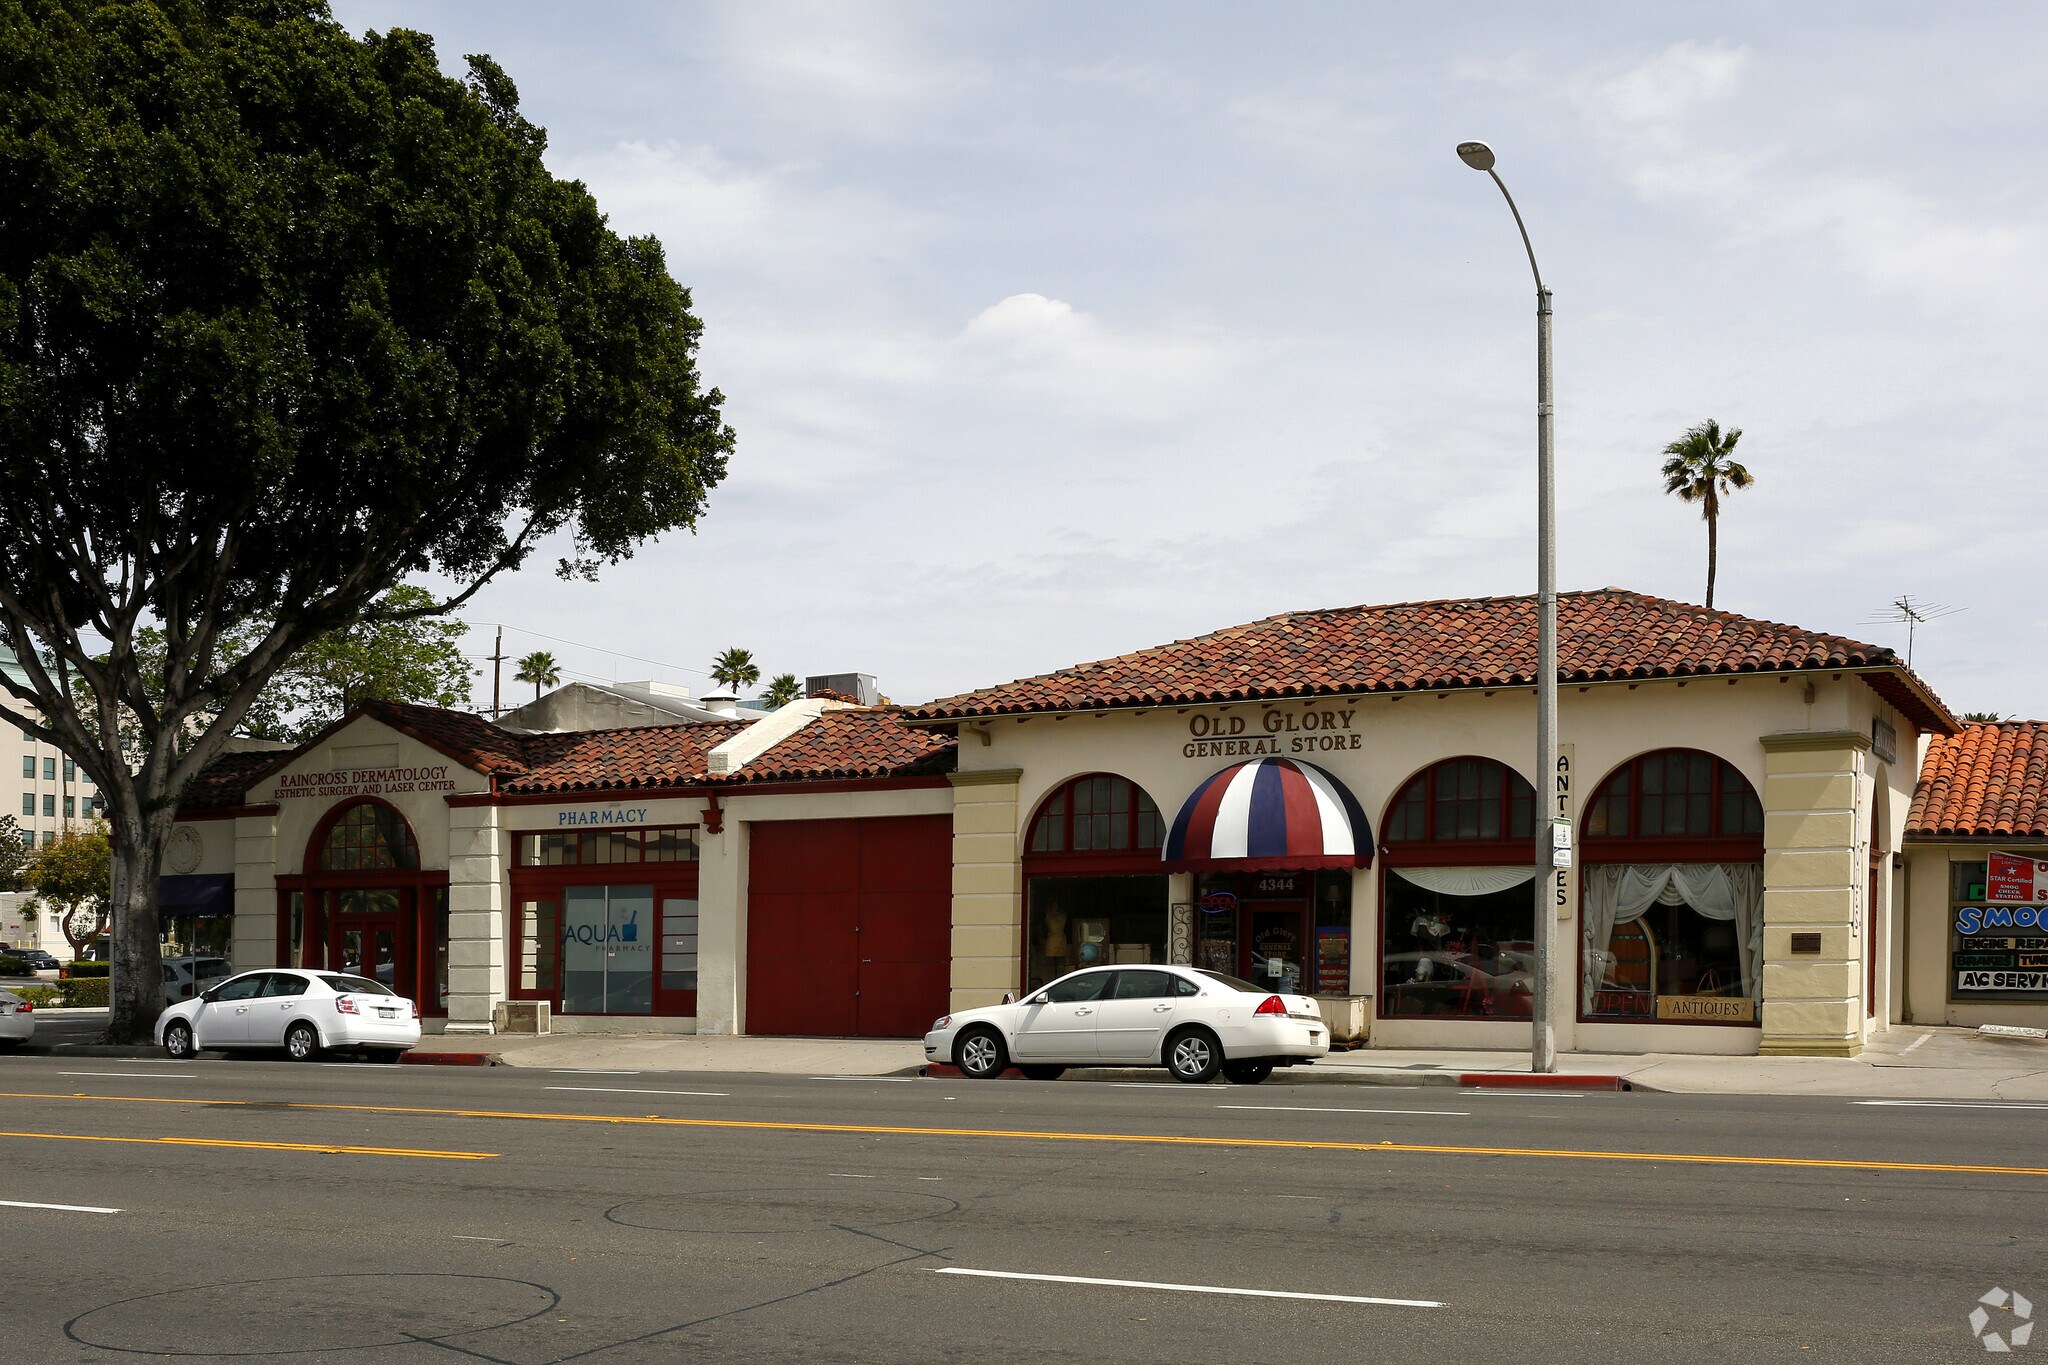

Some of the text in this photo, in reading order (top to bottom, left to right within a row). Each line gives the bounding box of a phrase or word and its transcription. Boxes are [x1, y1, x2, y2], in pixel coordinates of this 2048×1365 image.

[1189, 709, 1356, 737] OLD GLORY
[1182, 734, 1362, 758] GENERAL STORE
[280, 766, 448, 787] RAINCROSS DERMATOLOGY
[274, 780, 456, 799] ESTHETIC SURGERY AND LASER CENTER
[559, 808, 647, 825] PHARMACY
[1557, 755, 1569, 905] ANTES
[1259, 878, 1294, 891] 4344
[1200, 896, 1235, 910] OPEN
[564, 924, 620, 945] AQUA
[1964, 938, 2009, 949] ENGINE
[595, 944, 650, 952] PHARMACY
[1993, 973, 2048, 988] SERVI
[1593, 992, 1650, 1014] OPEN
[1672, 1000, 1740, 1016] ANTIQUES
